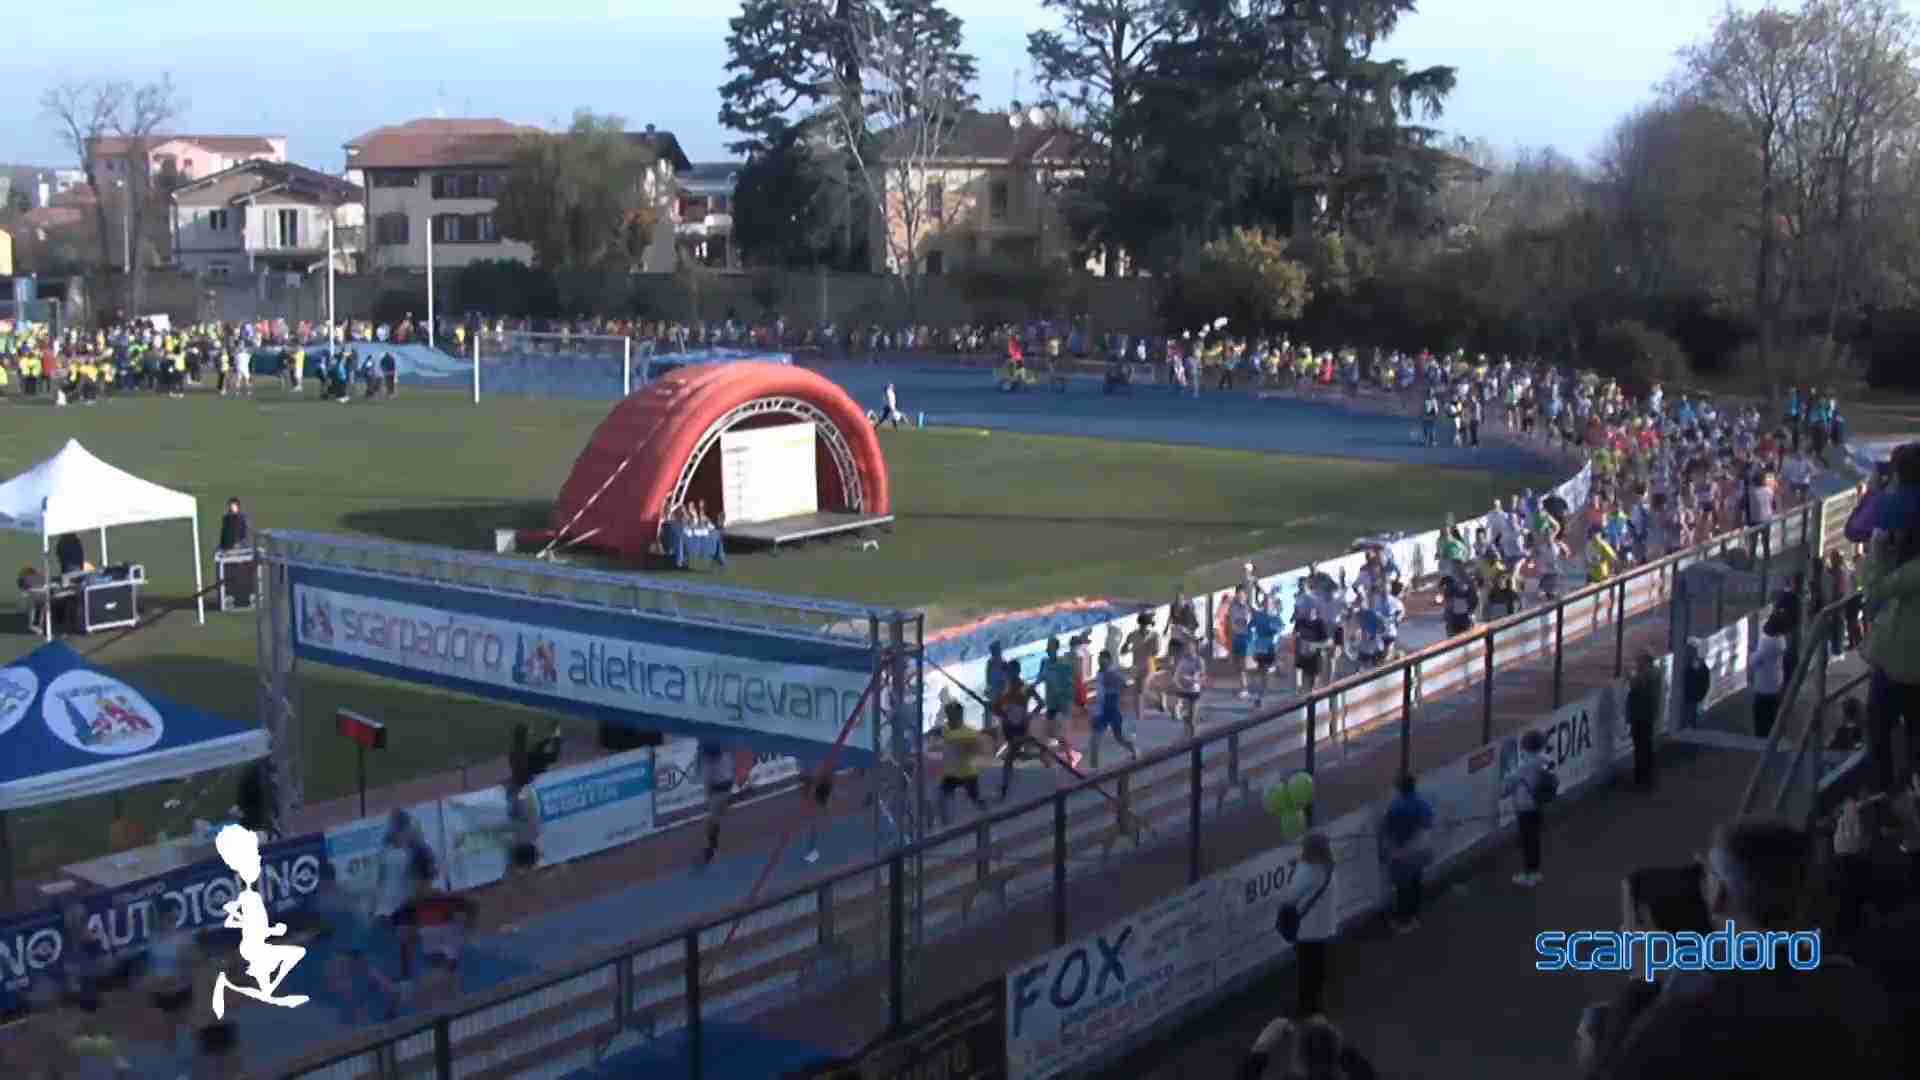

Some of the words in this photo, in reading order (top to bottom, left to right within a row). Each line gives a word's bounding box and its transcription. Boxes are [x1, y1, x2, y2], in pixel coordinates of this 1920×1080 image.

[340, 606, 503, 673] scarpadoro
[567, 641, 686, 702] atletica
[1012, 925, 1133, 1039] FOX
